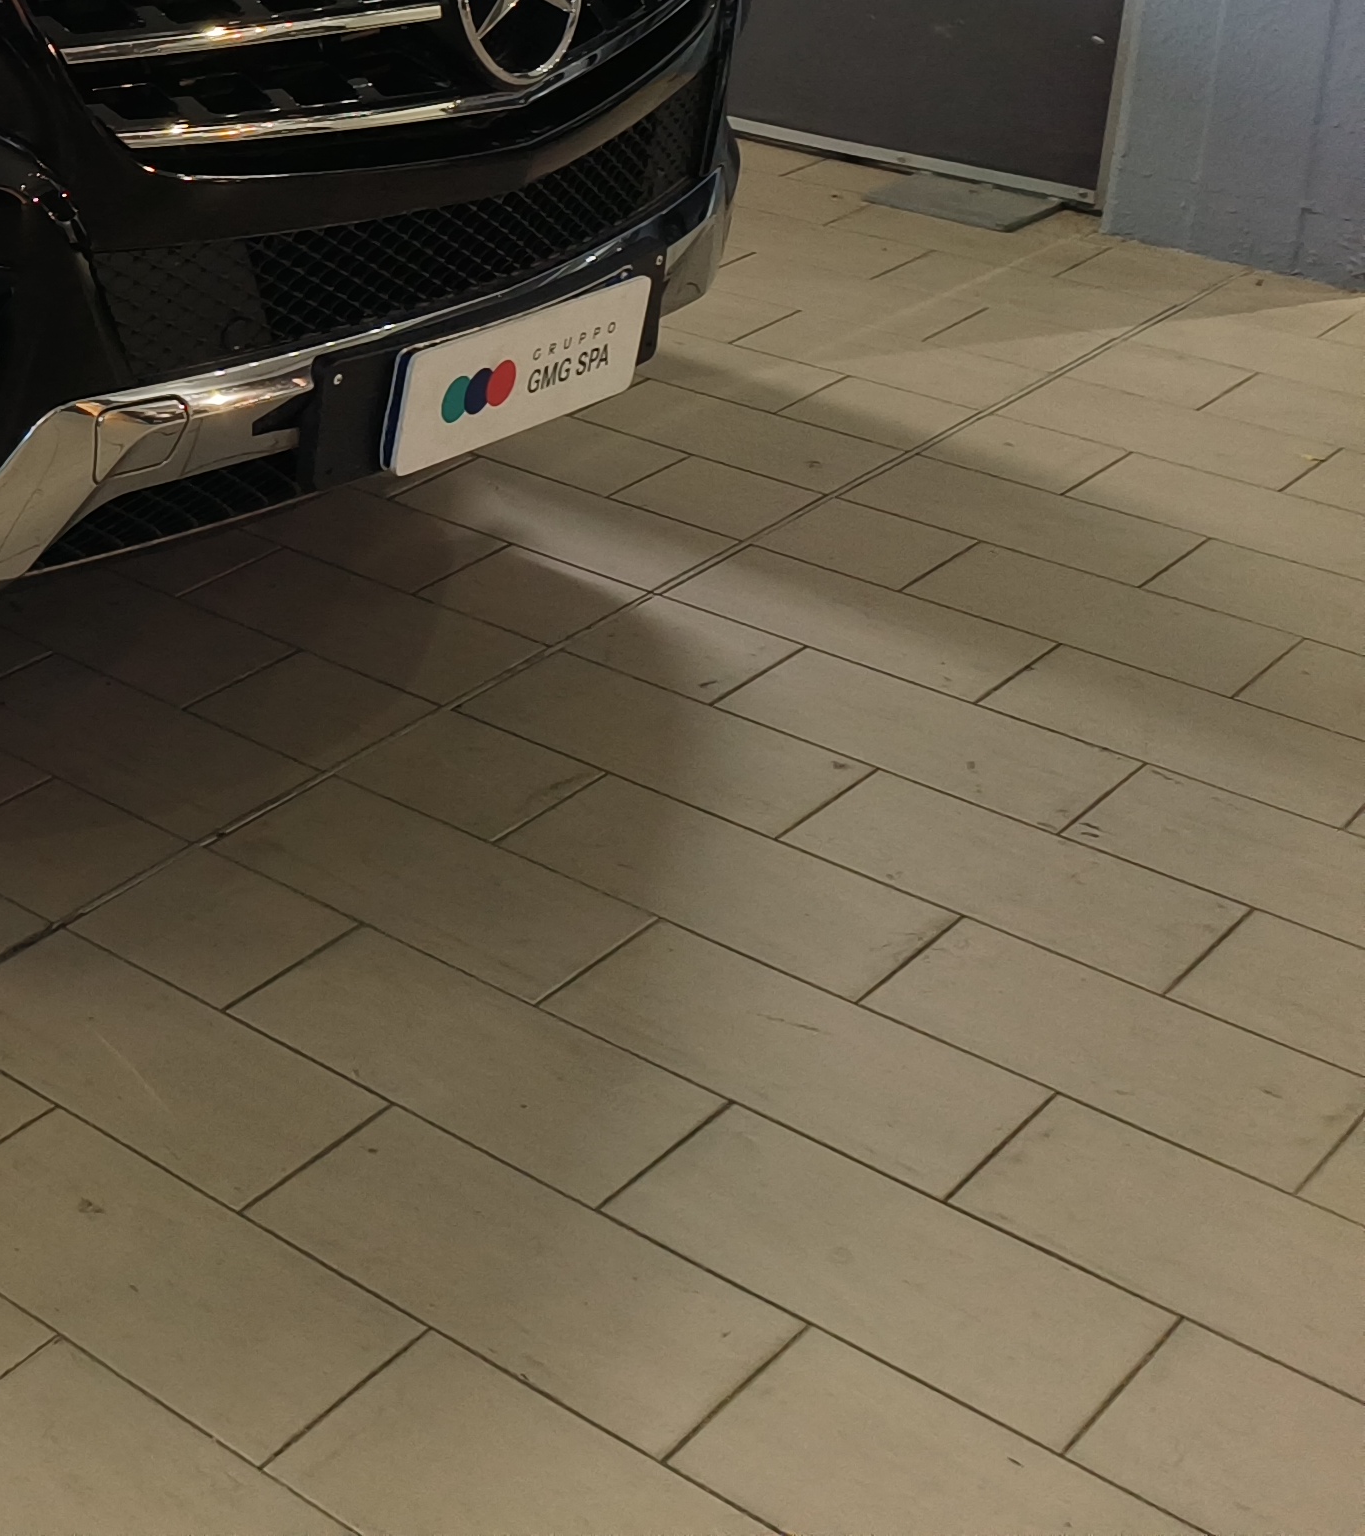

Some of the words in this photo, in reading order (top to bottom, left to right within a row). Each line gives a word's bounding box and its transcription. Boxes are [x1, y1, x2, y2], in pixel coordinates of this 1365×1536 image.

[532, 321, 617, 361] GRUPPO
[527, 358, 571, 394] GMG
[576, 343, 609, 376] SPA
